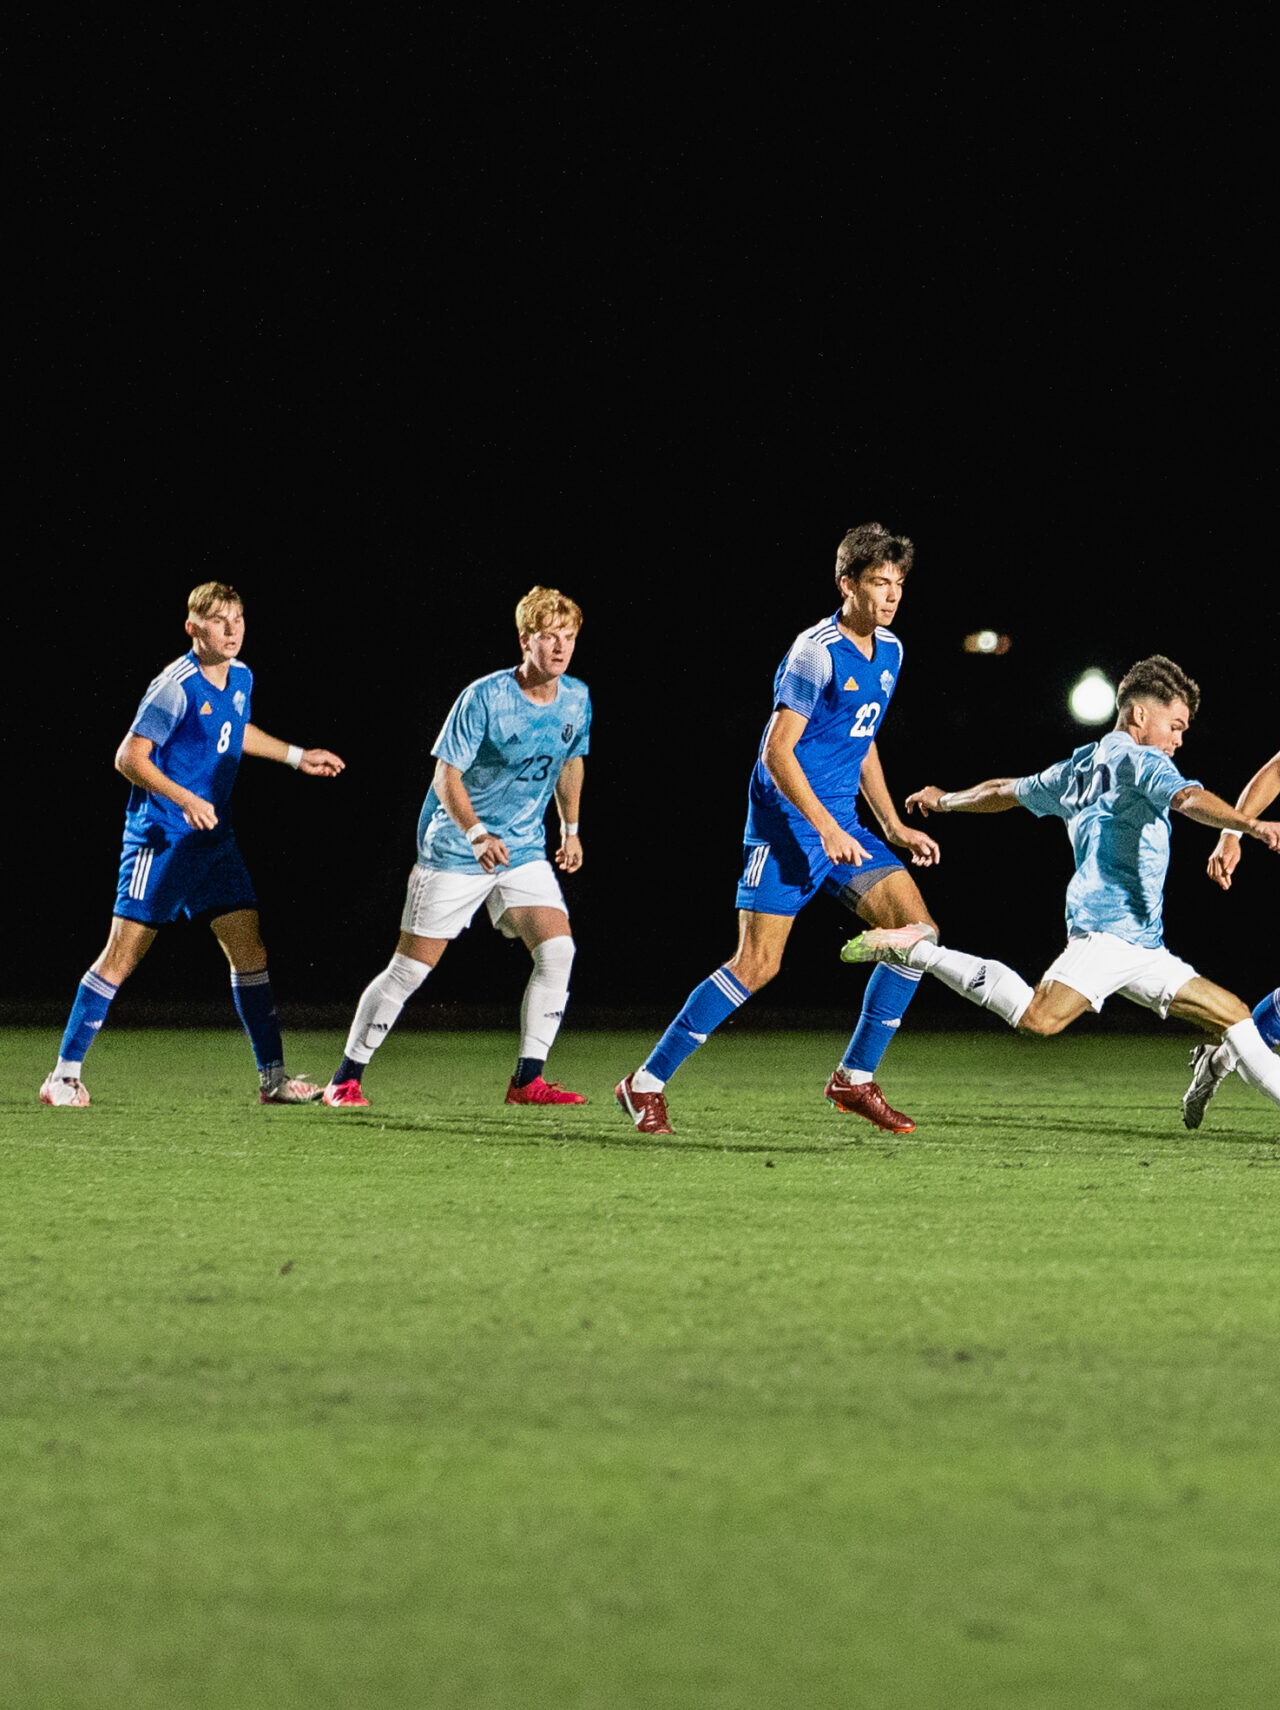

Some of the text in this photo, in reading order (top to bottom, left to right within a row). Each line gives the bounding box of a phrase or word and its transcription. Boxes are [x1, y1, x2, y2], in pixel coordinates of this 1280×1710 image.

[850, 702, 881, 738] 22
[217, 721, 232, 754] 8
[516, 755, 553, 782] 23
